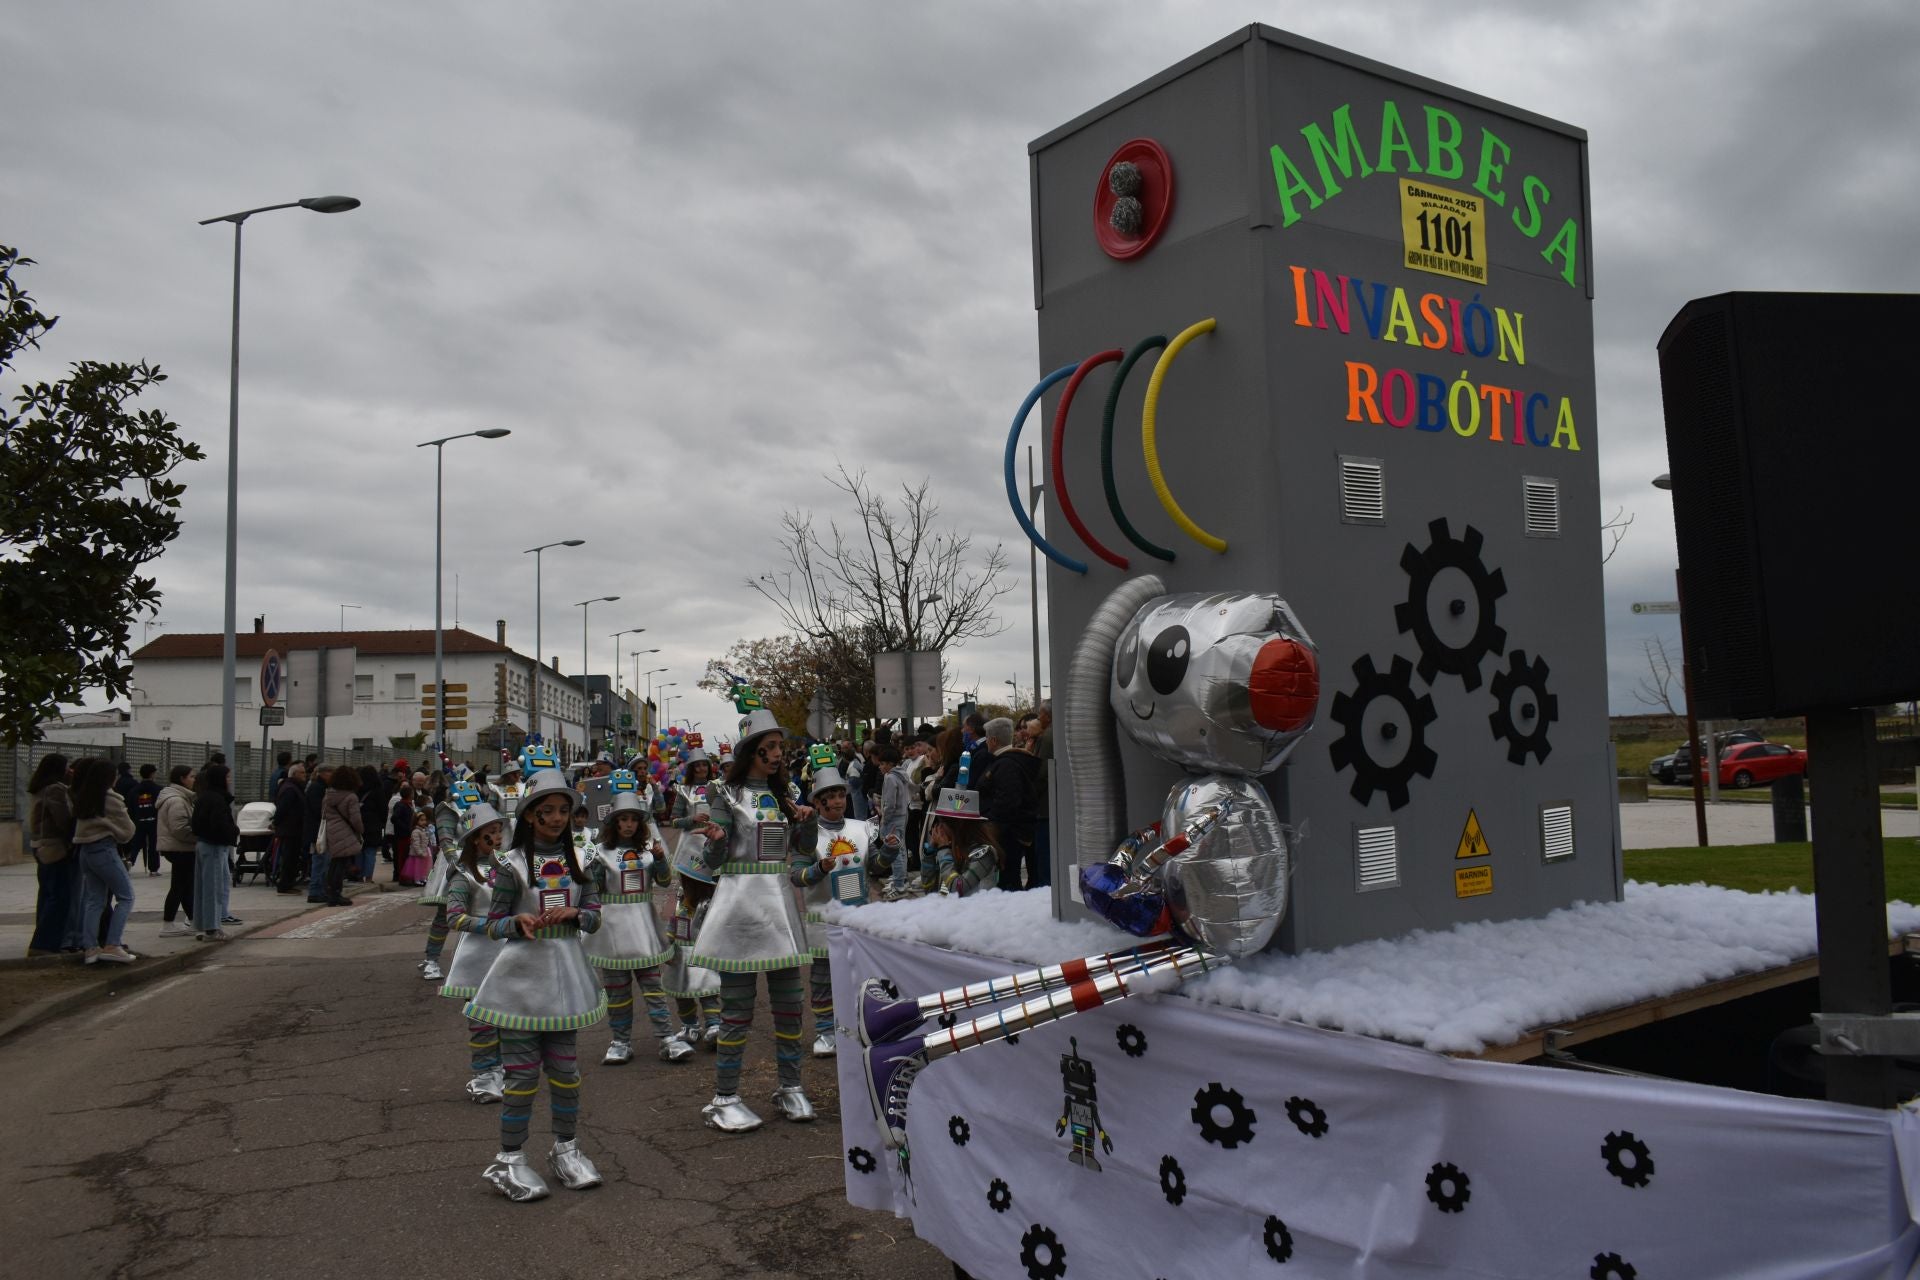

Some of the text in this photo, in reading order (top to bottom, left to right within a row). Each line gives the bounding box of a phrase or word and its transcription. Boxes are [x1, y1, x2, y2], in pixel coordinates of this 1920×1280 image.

[1269, 100, 1580, 288] AMABESA
[1407, 185, 1477, 212] CARNAVAL 2025
[1421, 201, 1467, 218] MIAJADAS
[1416, 209, 1474, 261] 1101
[1289, 265, 1525, 365] INVASIÓN
[1344, 361, 1581, 451] ROBÓTICA
[1459, 869, 1489, 880] WARNING
